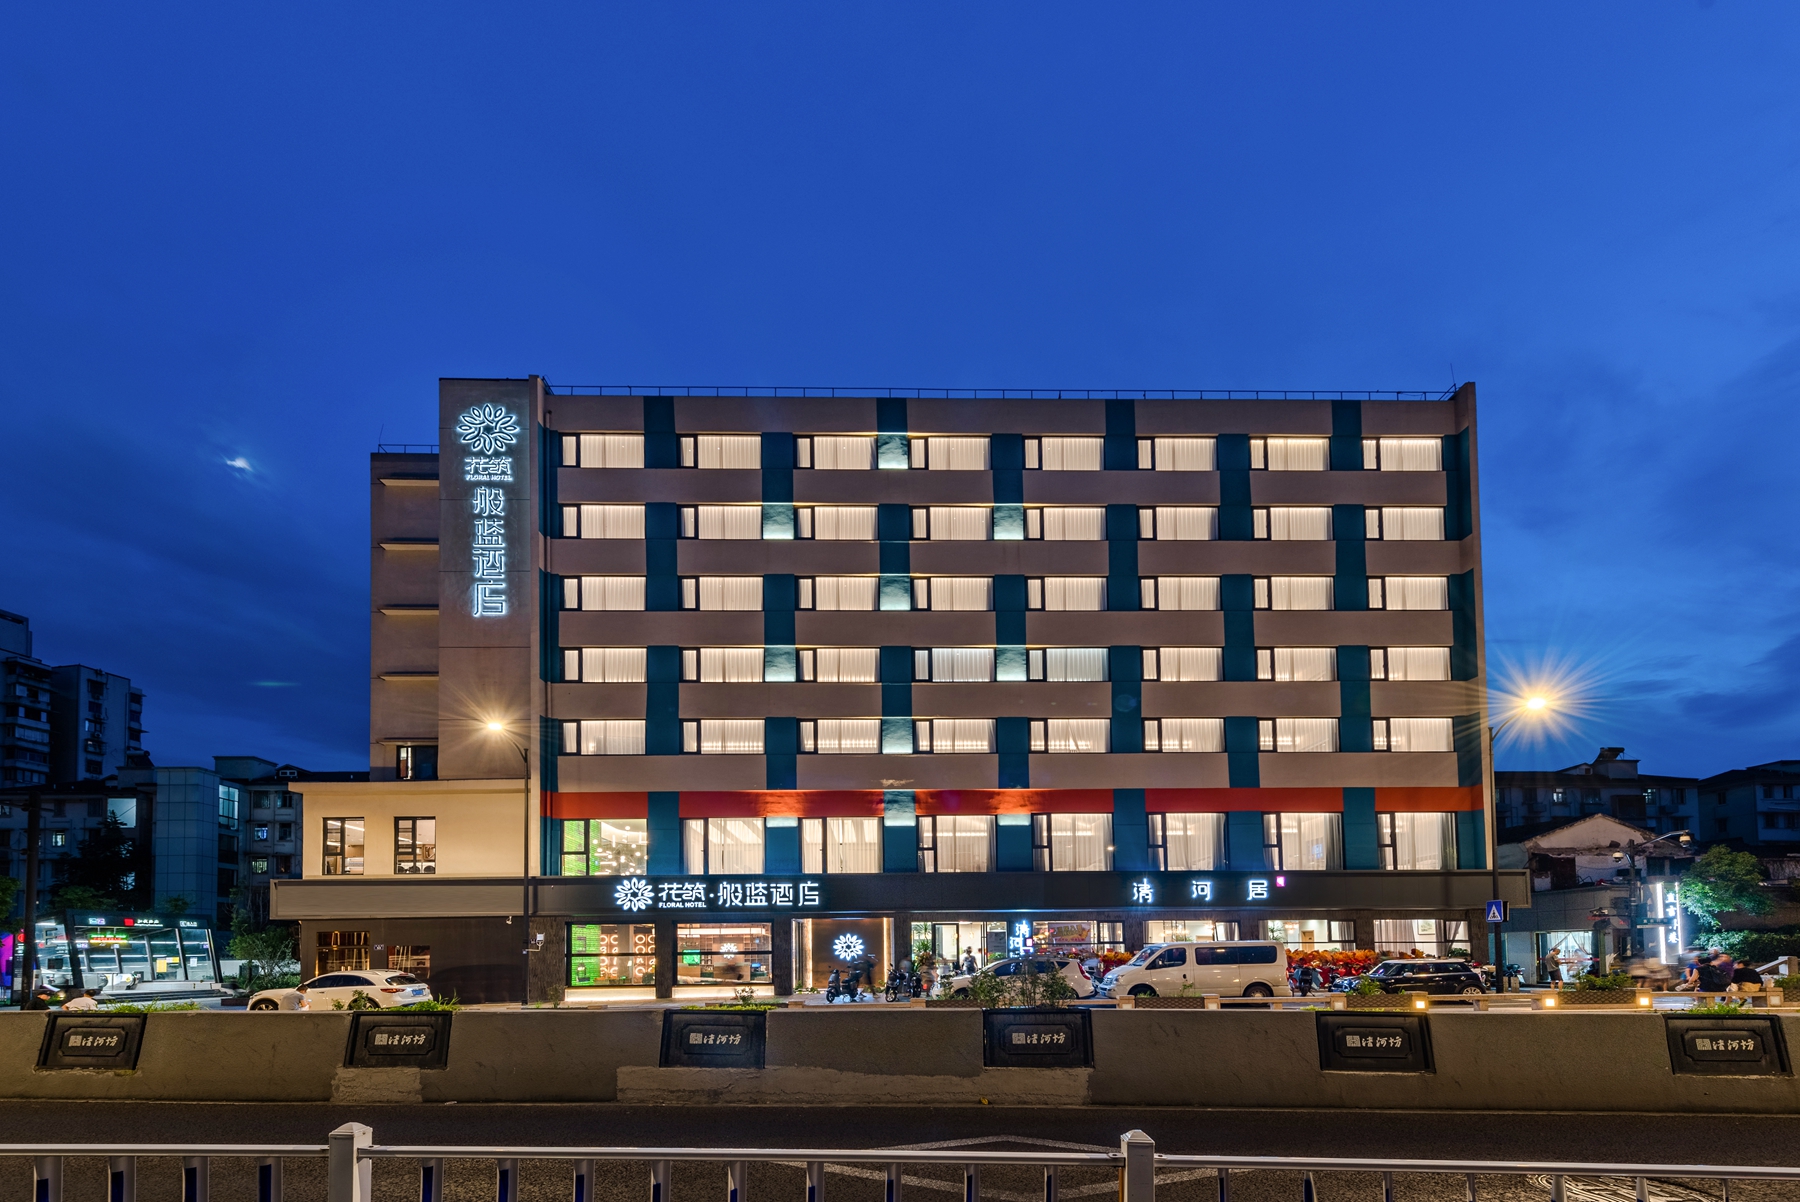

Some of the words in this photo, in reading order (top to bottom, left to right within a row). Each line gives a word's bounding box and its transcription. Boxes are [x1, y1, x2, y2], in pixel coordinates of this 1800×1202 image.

[464, 456, 512, 474] 花筑
[1132, 878, 1269, 903] 清河居
